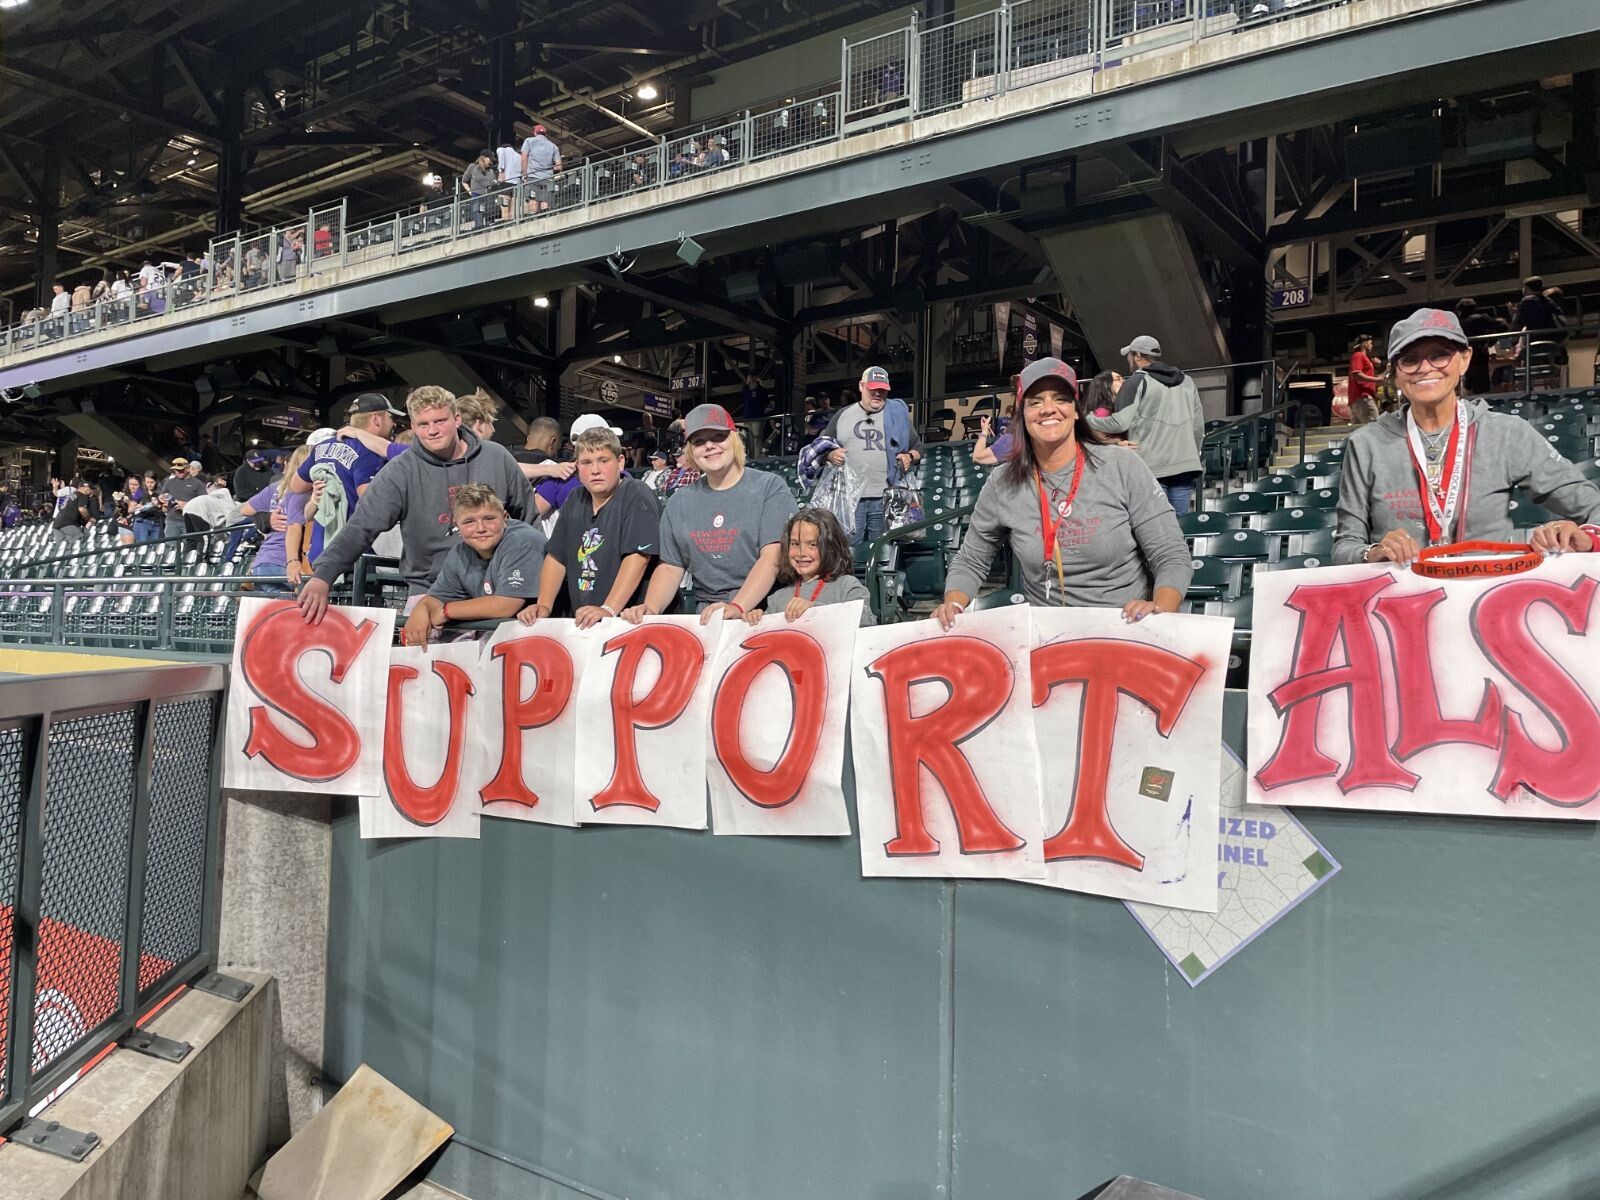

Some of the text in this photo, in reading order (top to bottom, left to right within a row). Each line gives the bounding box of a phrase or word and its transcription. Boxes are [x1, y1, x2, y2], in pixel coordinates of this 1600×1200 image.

[1282, 289, 1305, 306] 208
[672, 376, 700, 390] 206 207
[241, 600, 1207, 872] SUPPORT
[1255, 572, 1600, 809] ALS
